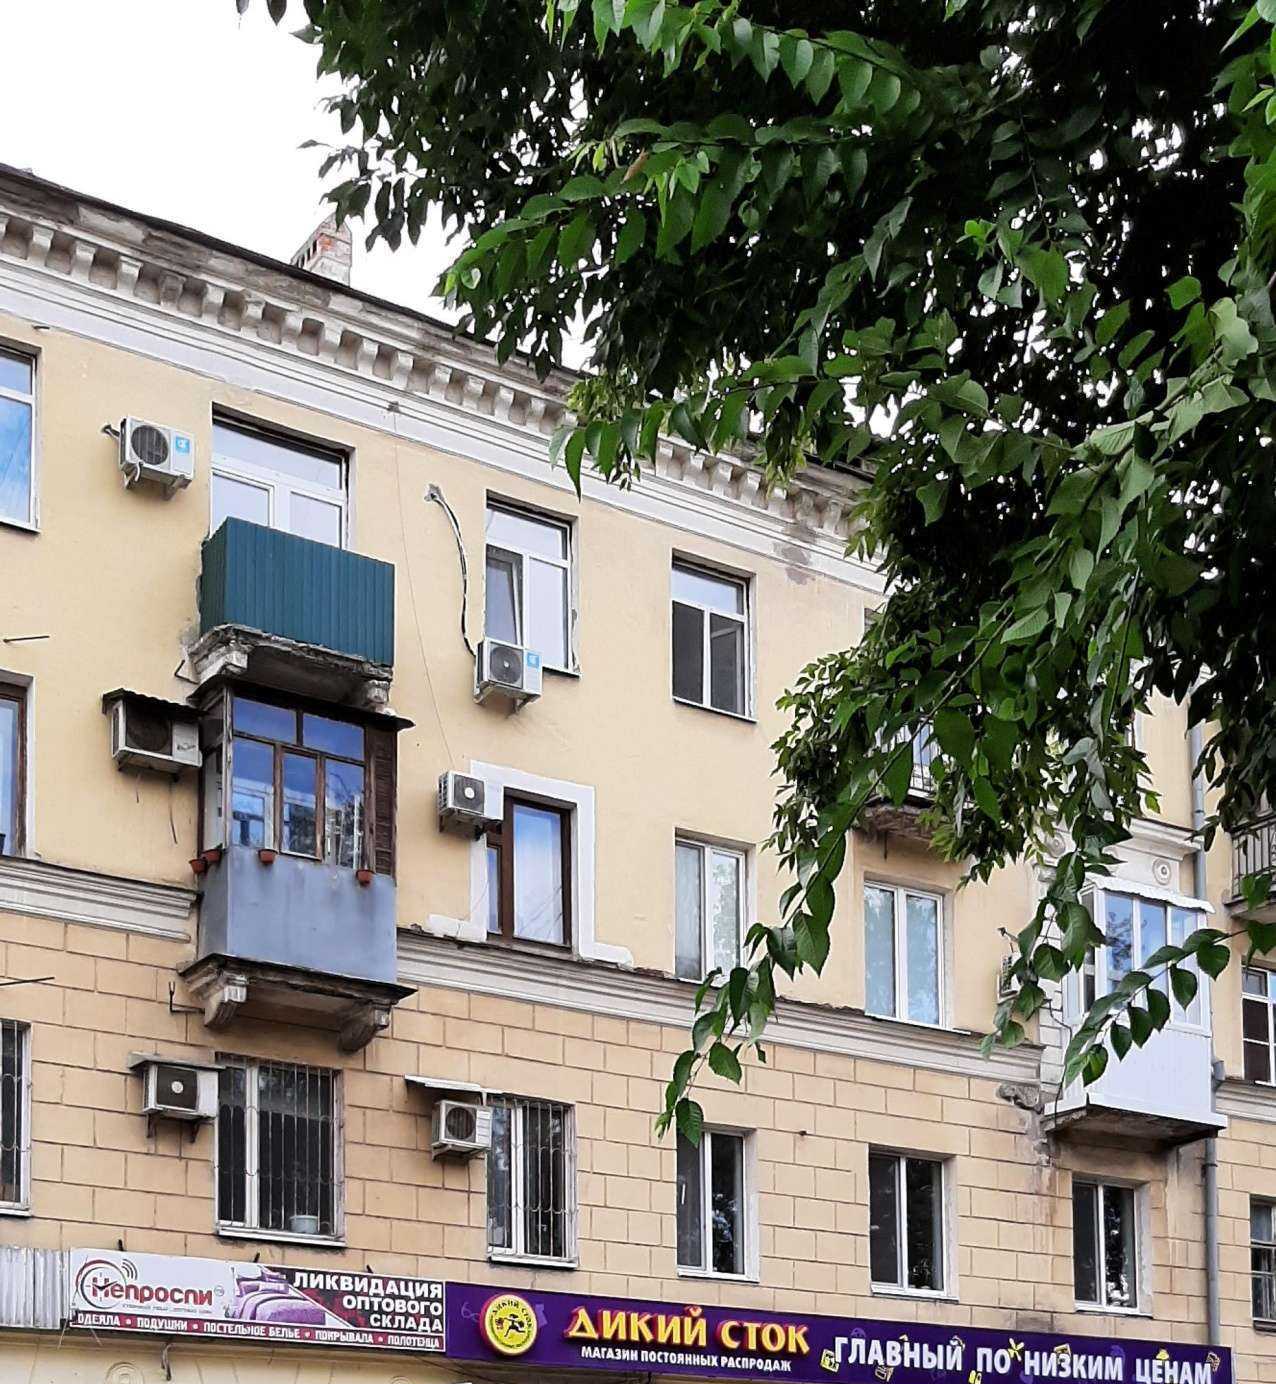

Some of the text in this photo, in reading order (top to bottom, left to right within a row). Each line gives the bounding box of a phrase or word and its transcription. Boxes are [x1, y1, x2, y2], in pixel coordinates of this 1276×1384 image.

[91, 1277, 213, 1306] Непроспи
[293, 1272, 442, 1300] ЛИКВИДАЦИЯ
[342, 1295, 443, 1316] ОПТОВОГО
[77, 1313, 441, 1349] ОДЕЯЛА ПОДУШКИ ПОСТЕЛЬНОЕ БЕЛЬЕ ПОКРЫВАЛА ПОЛОТЕНЦА
[369, 1314, 443, 1333] СКЛАДА
[563, 1305, 810, 1354] ДИКИЙ СТОК
[581, 1345, 792, 1373] МАГАЗИН ПОСТОЯННЫХ РАСПРОДАЖ
[834, 1335, 962, 1371] ГЛАВНЫЙ
[976, 1346, 1012, 1374] ПО
[1024, 1352, 1123, 1382] НИЗКИМ
